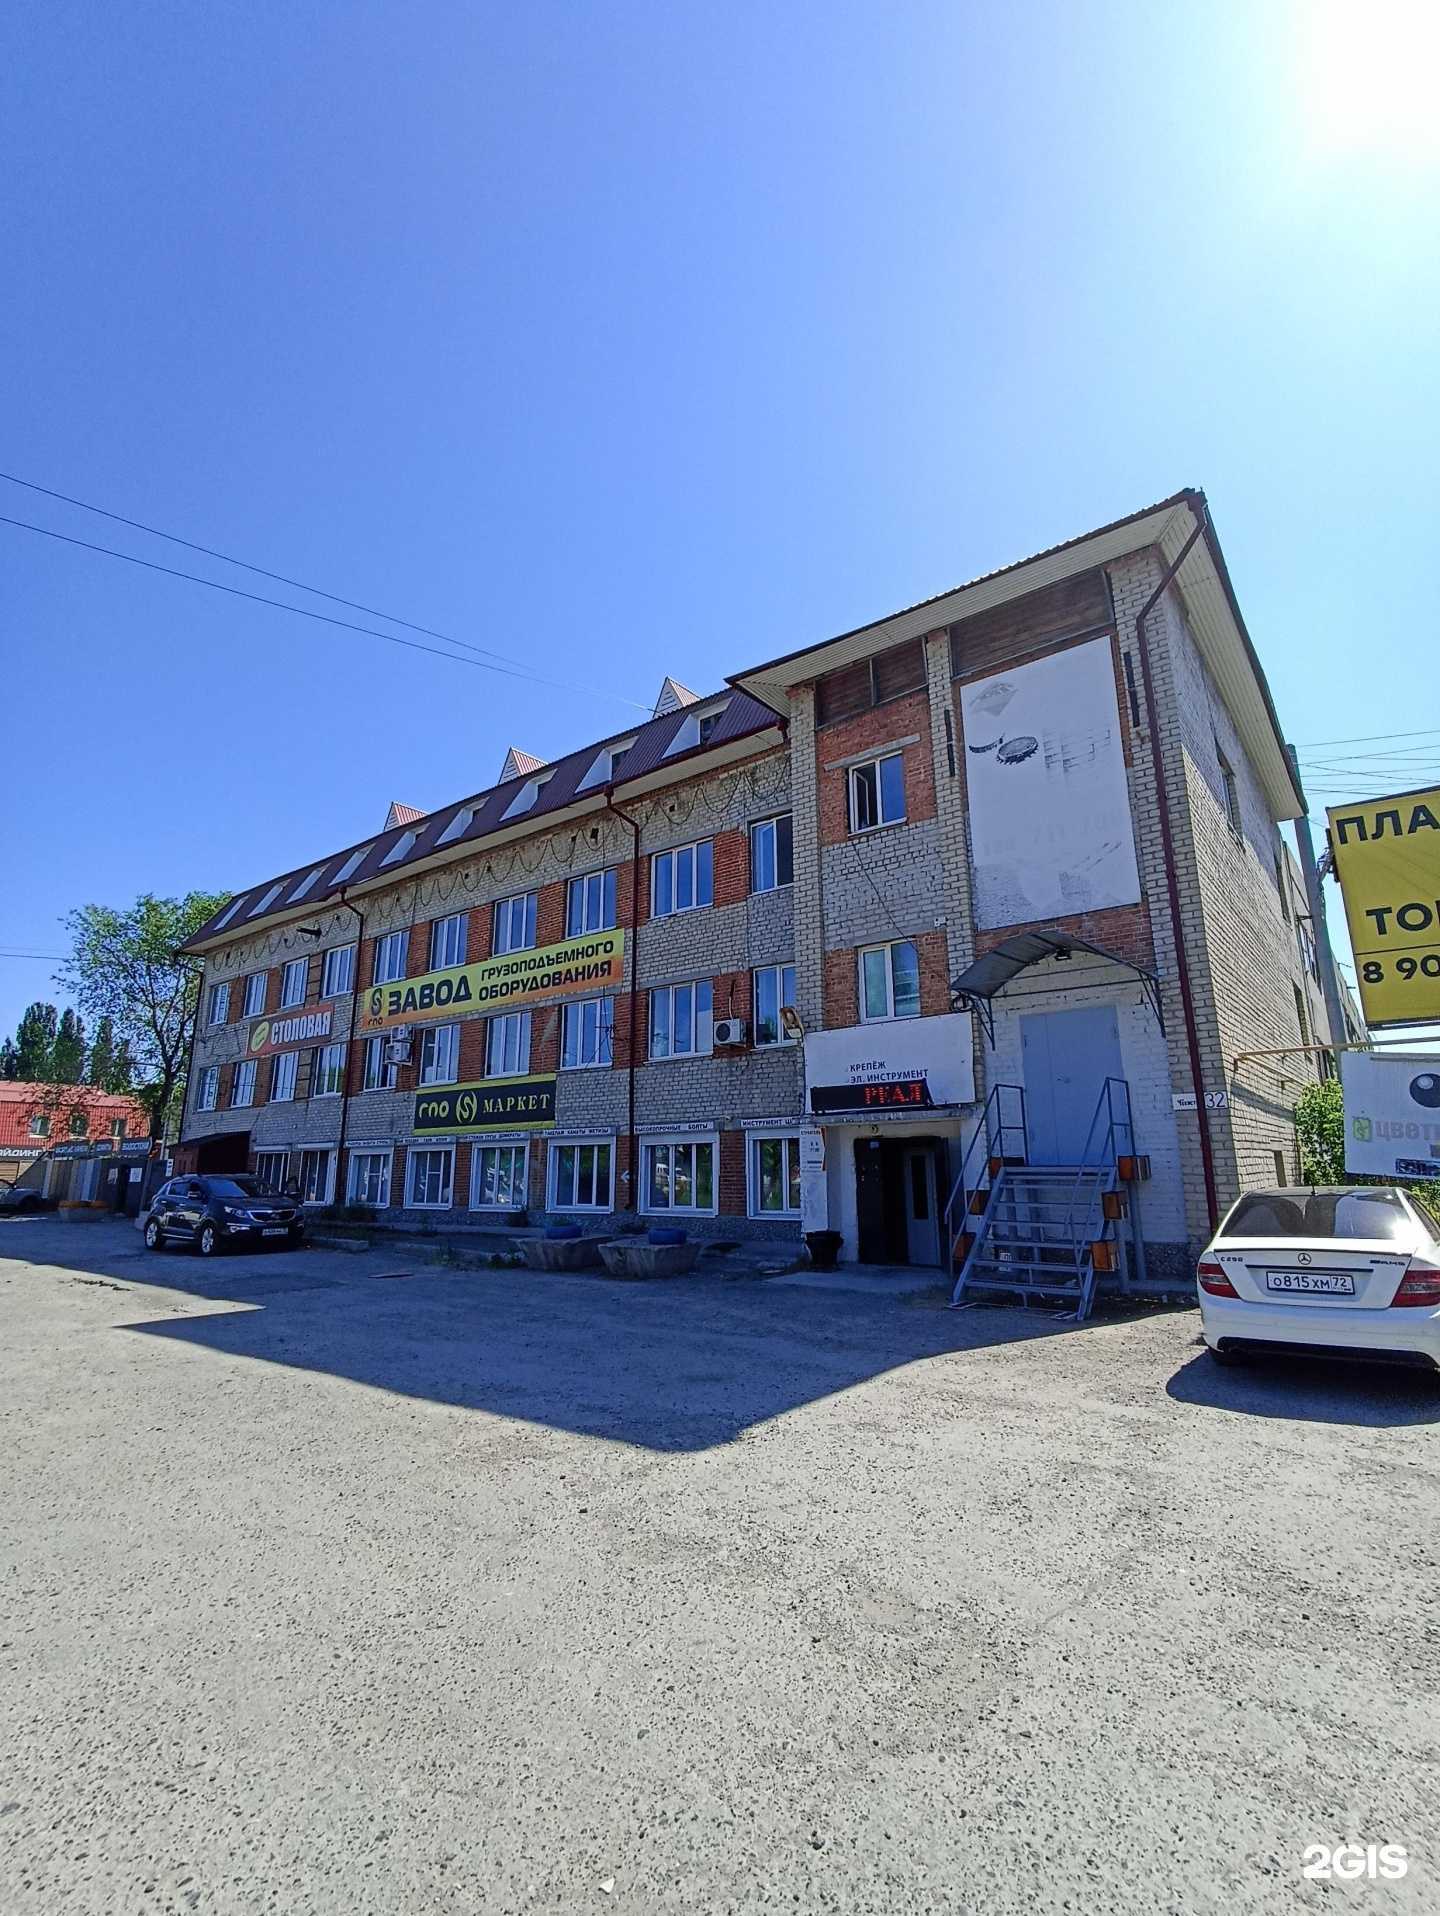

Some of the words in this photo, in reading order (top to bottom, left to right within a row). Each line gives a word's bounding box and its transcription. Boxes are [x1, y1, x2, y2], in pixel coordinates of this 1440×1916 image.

[1366, 901, 1440, 936] ТО
[481, 940, 614, 981] ГРУЗОПОДЪЕМНОГО
[479, 959, 612, 1001] ОБОРУДОВАНИЯ
[1362, 961, 1385, 984] 8
[388, 975, 472, 1016] ЗАВОД
[271, 1011, 332, 1045] СТОЛОВАЯ
[850, 1061, 887, 1073] КРЕПЁЖ
[867, 1069, 929, 1083] ИНСТРУМЕНТ
[483, 1093, 550, 1113] МАРКЕТ
[1204, 1091, 1226, 1109] 32
[688, 1122, 709, 1130] БОЛТЫ
[1332, 1276, 1348, 1288] 72
